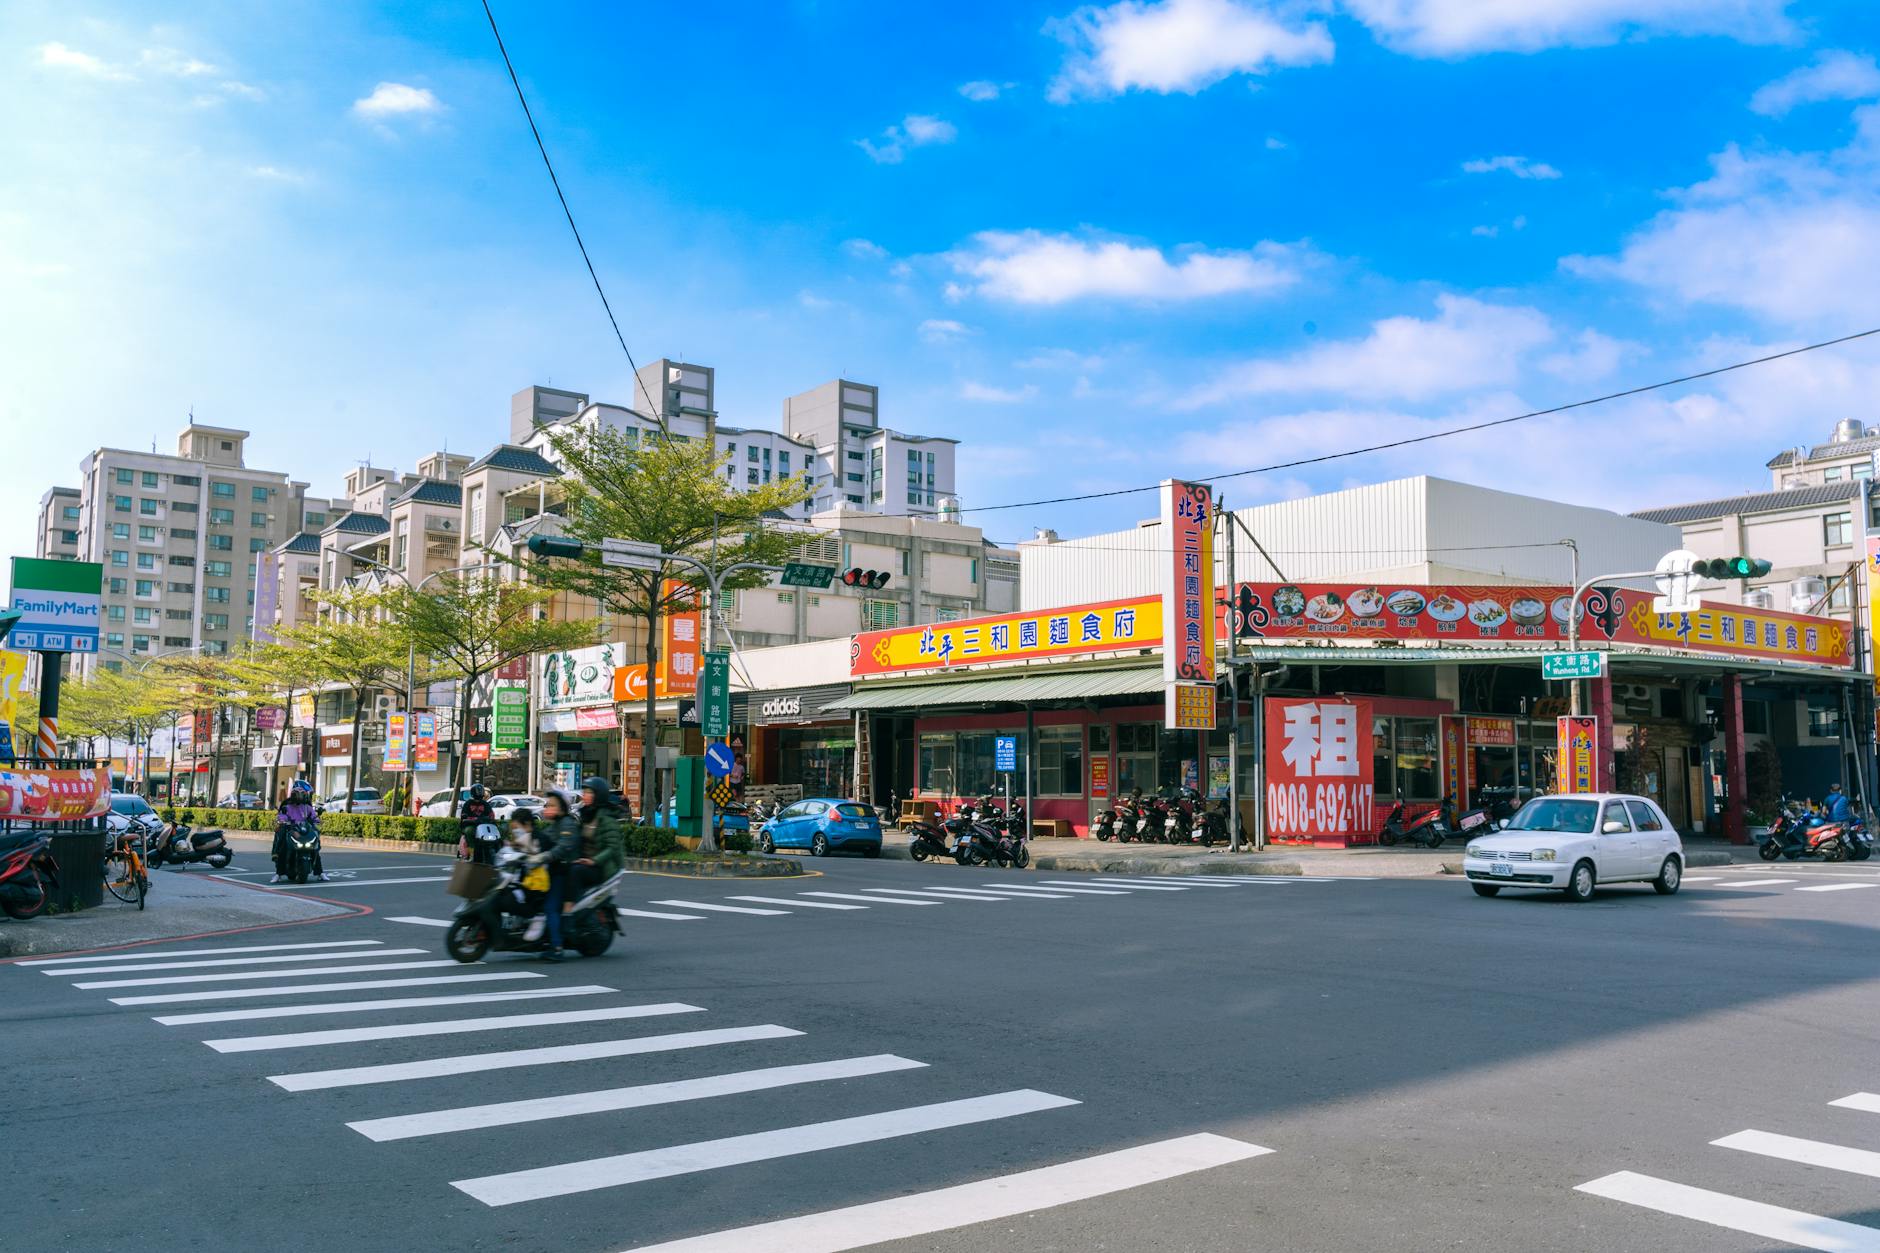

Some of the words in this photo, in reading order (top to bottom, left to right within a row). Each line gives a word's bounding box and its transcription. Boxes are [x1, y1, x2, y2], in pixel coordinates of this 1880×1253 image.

[1178, 496, 1208, 666] 北平三和園麵食府
[14, 598, 98, 616] FamilyMart
[46, 636, 62, 646] ATM
[920, 608, 1137, 666] 北平三和園麵食府
[763, 697, 800, 716] adidas
[997, 739, 1005, 749] P
[1281, 701, 1360, 777] 租
[1571, 736, 1593, 793] 北平三和園
[1267, 783, 1373, 833] 0908-692-117
